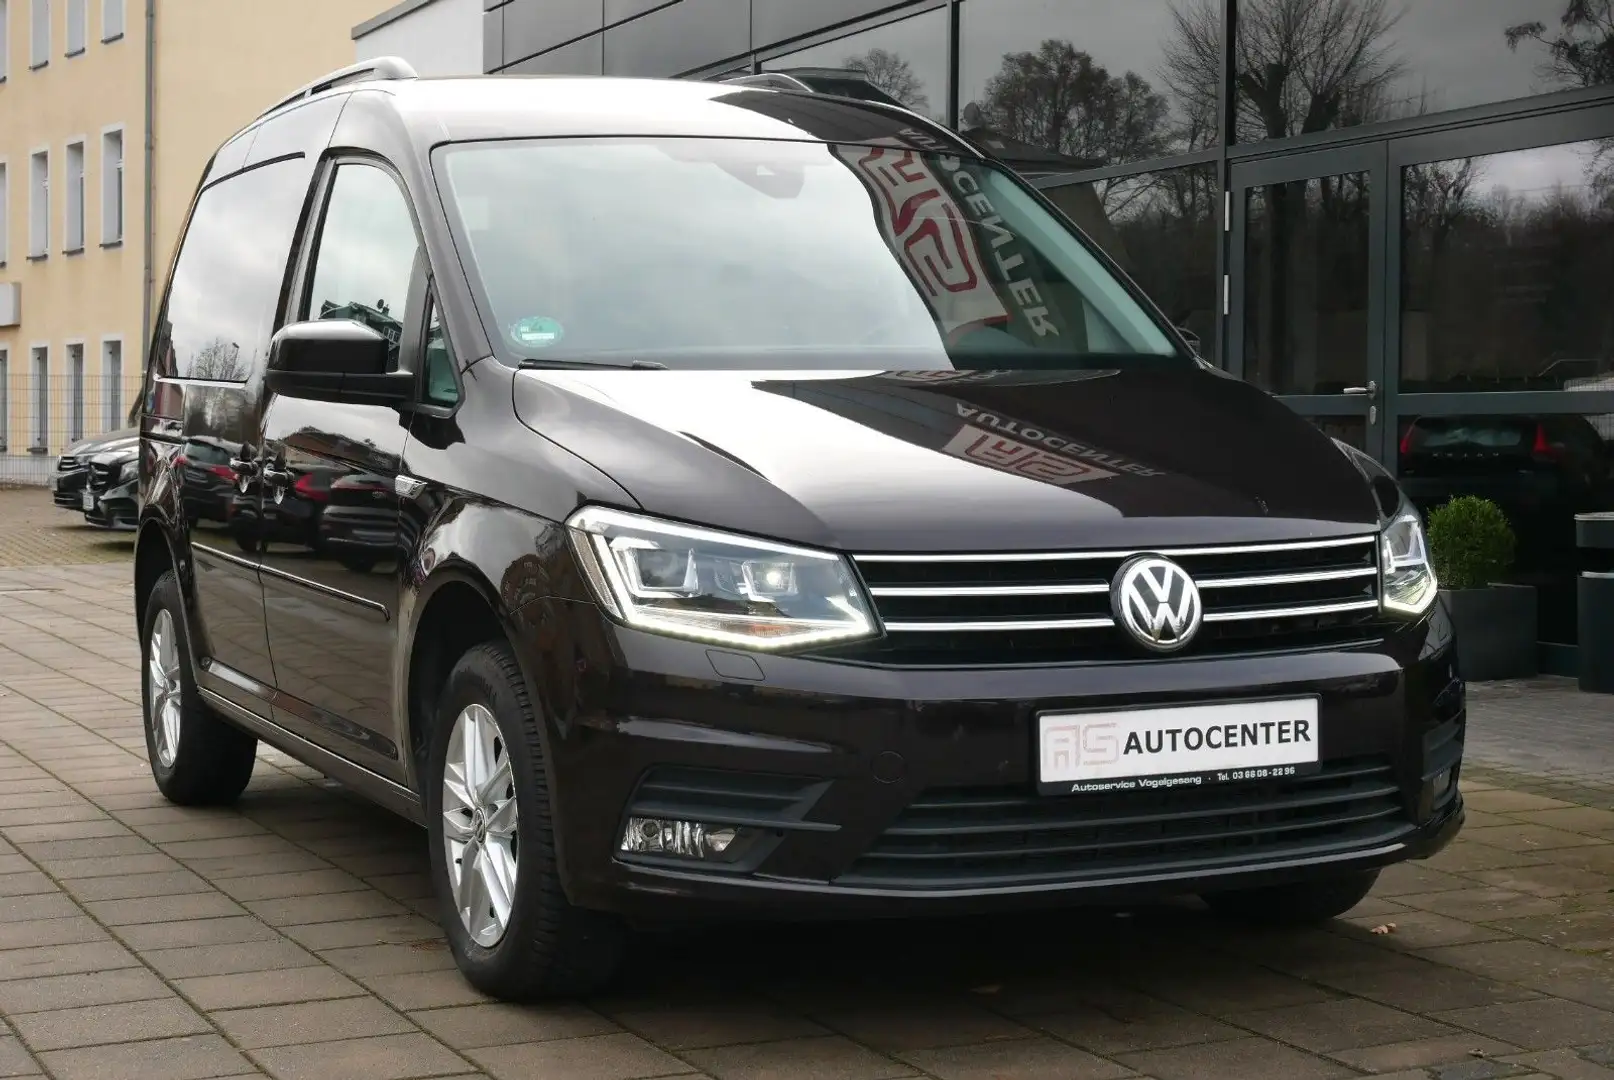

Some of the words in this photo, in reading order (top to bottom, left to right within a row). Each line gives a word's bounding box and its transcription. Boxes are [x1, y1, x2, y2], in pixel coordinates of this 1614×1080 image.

[1120, 558, 1202, 645] VW
[1123, 719, 1311, 755] AUTOCENTER
[1071, 780, 1136, 792] Autoservice
[1138, 776, 1202, 788] Vogelgesang
[1217, 772, 1230, 781] Tel.
